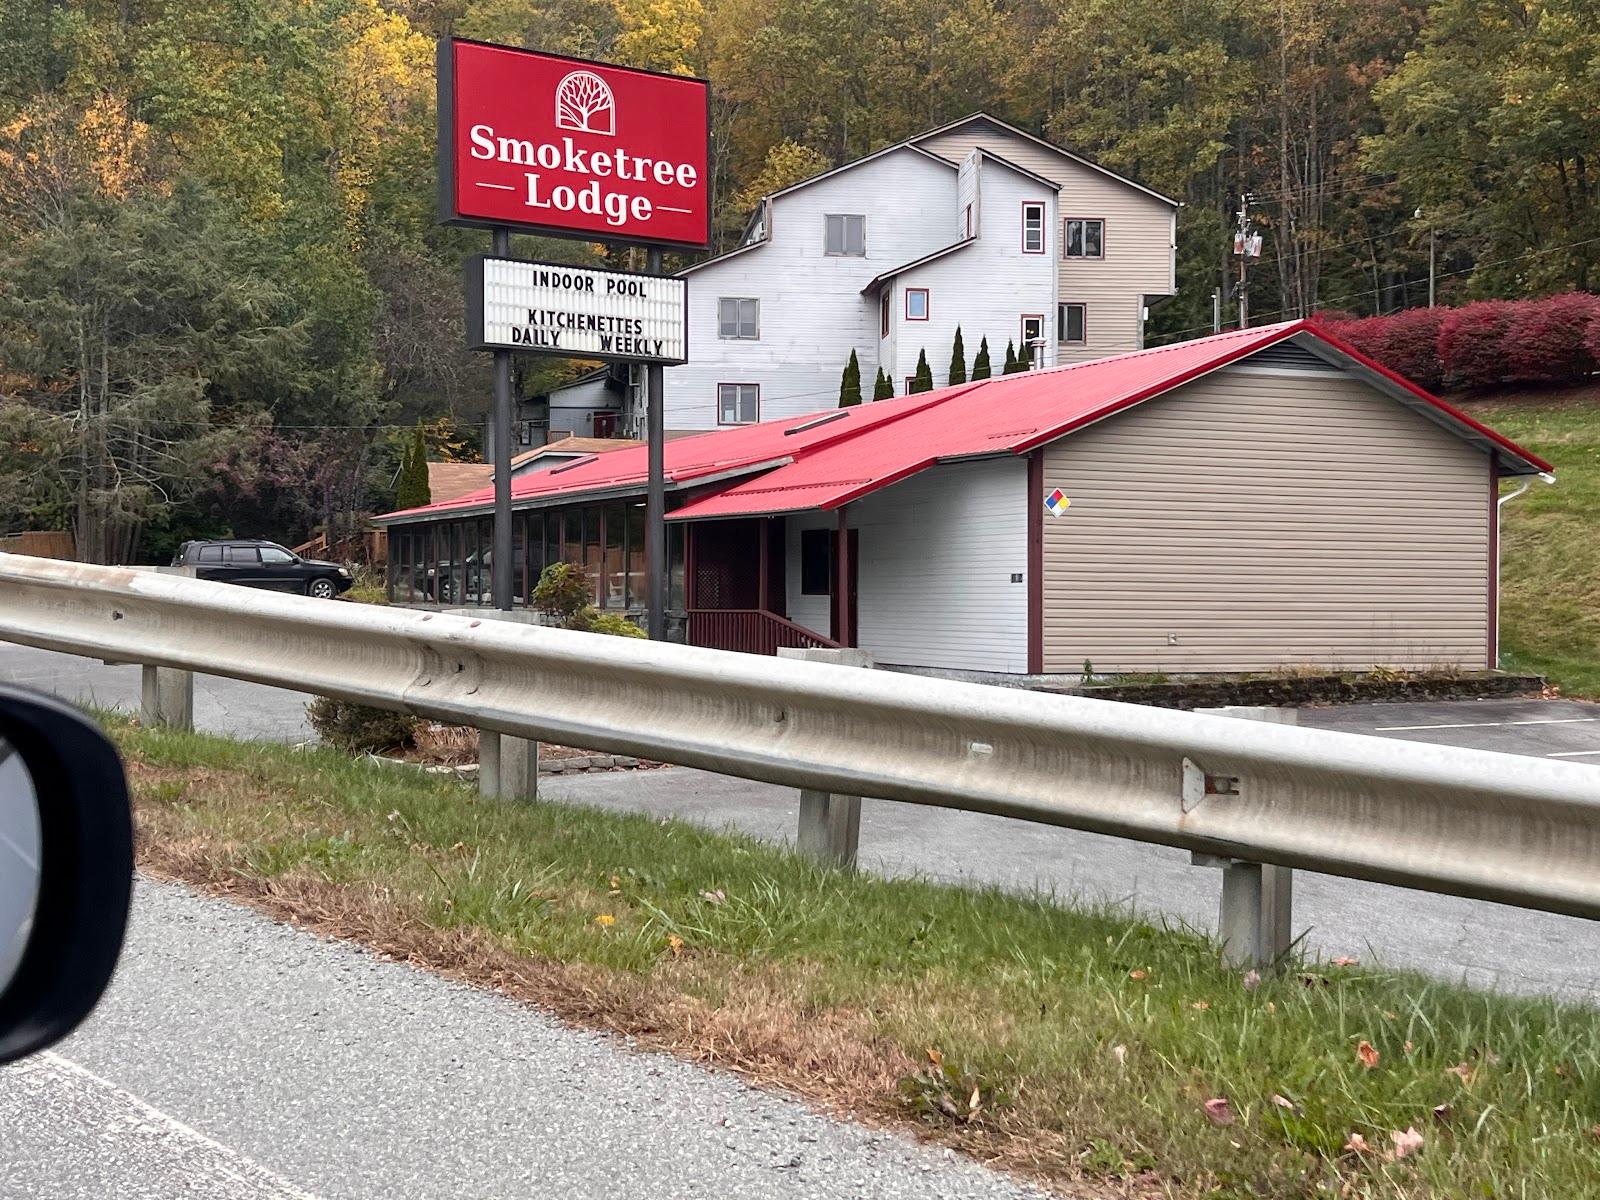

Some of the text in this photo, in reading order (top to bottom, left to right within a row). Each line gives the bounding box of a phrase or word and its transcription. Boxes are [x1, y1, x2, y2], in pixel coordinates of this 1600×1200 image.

[469, 124, 697, 188] Smoketree
[524, 172, 653, 226] Lodge
[533, 270, 647, 298] INDOOR POOL
[528, 309, 642, 335] KITCHENETTES
[512, 326, 663, 356] DAILY WEEKLY
